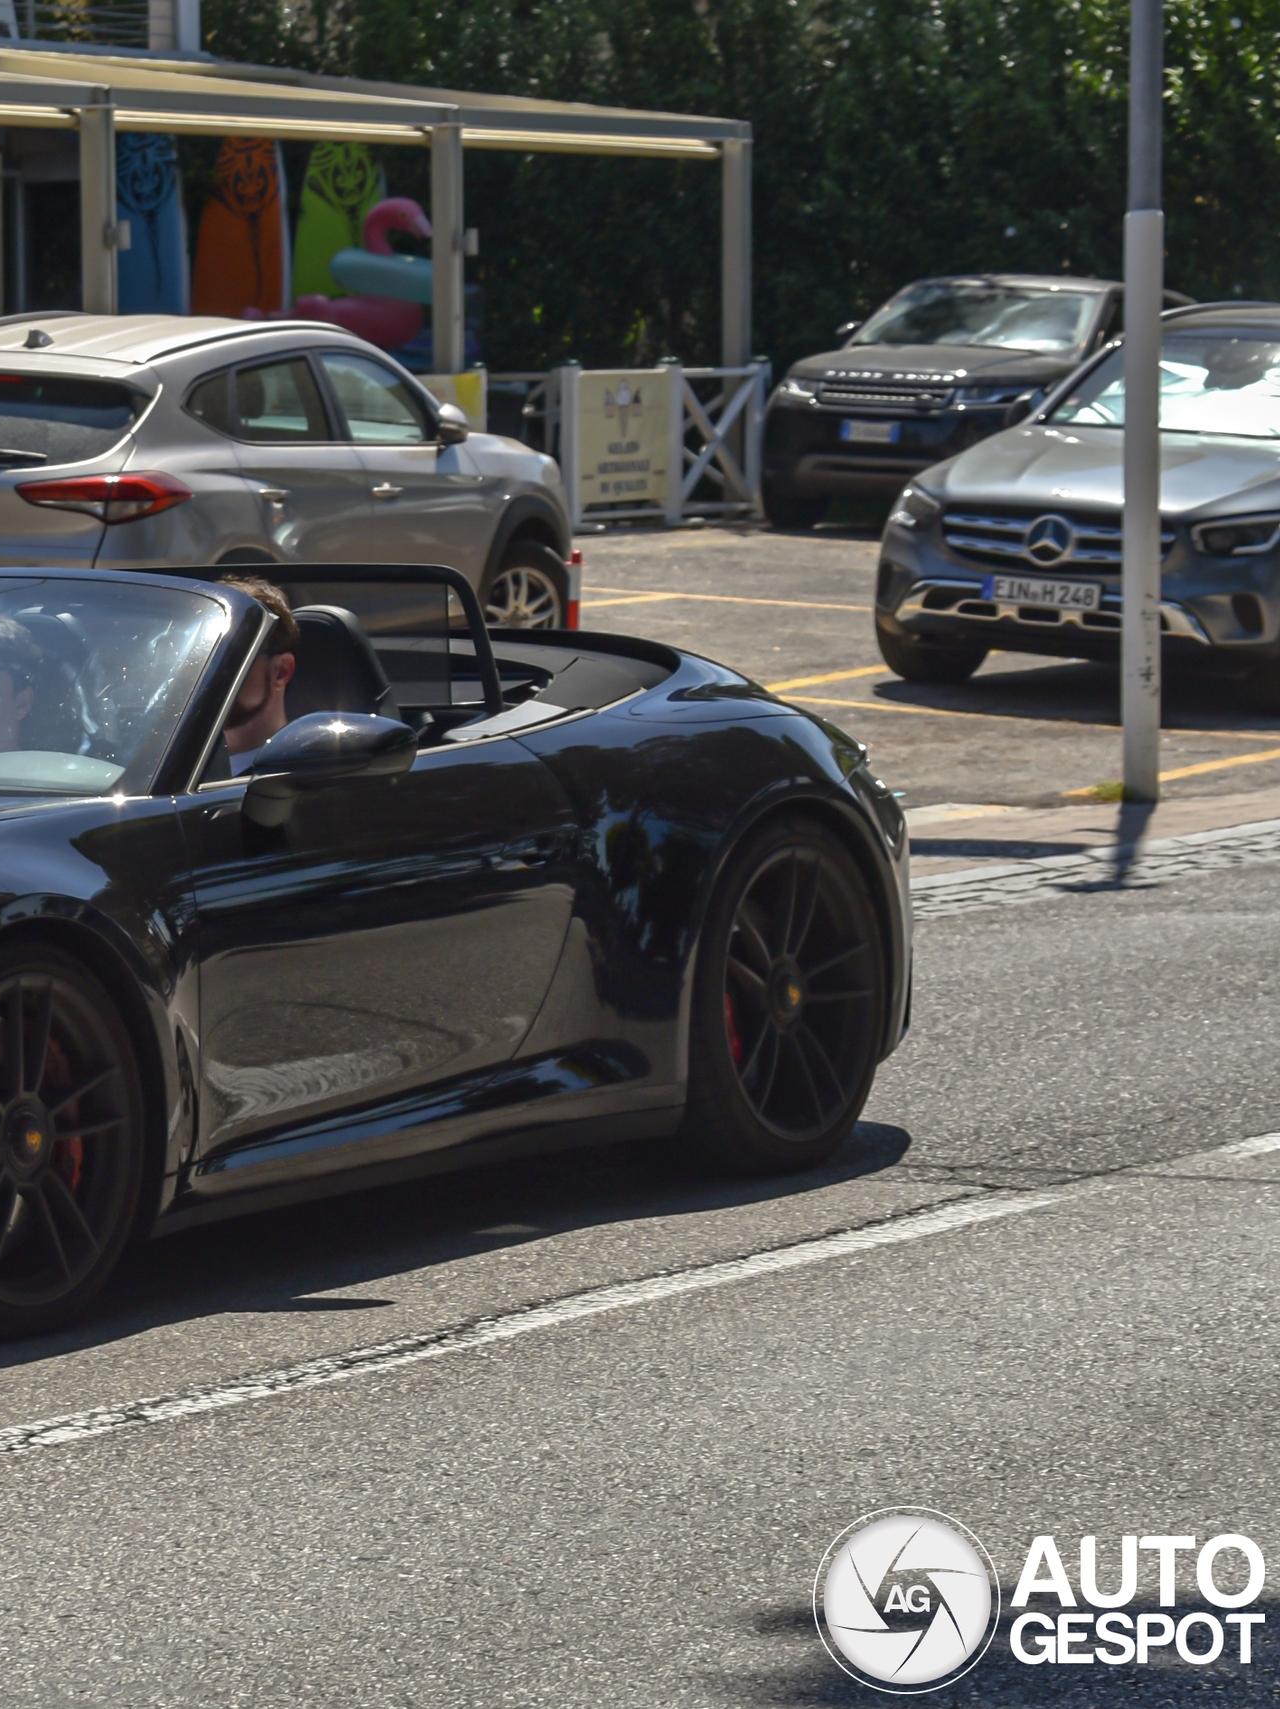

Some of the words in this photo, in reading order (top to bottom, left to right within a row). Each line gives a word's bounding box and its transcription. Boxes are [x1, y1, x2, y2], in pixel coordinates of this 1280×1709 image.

[994, 579, 1030, 600] EIN
[1042, 583, 1056, 603] H
[1058, 585, 1096, 607] 248
